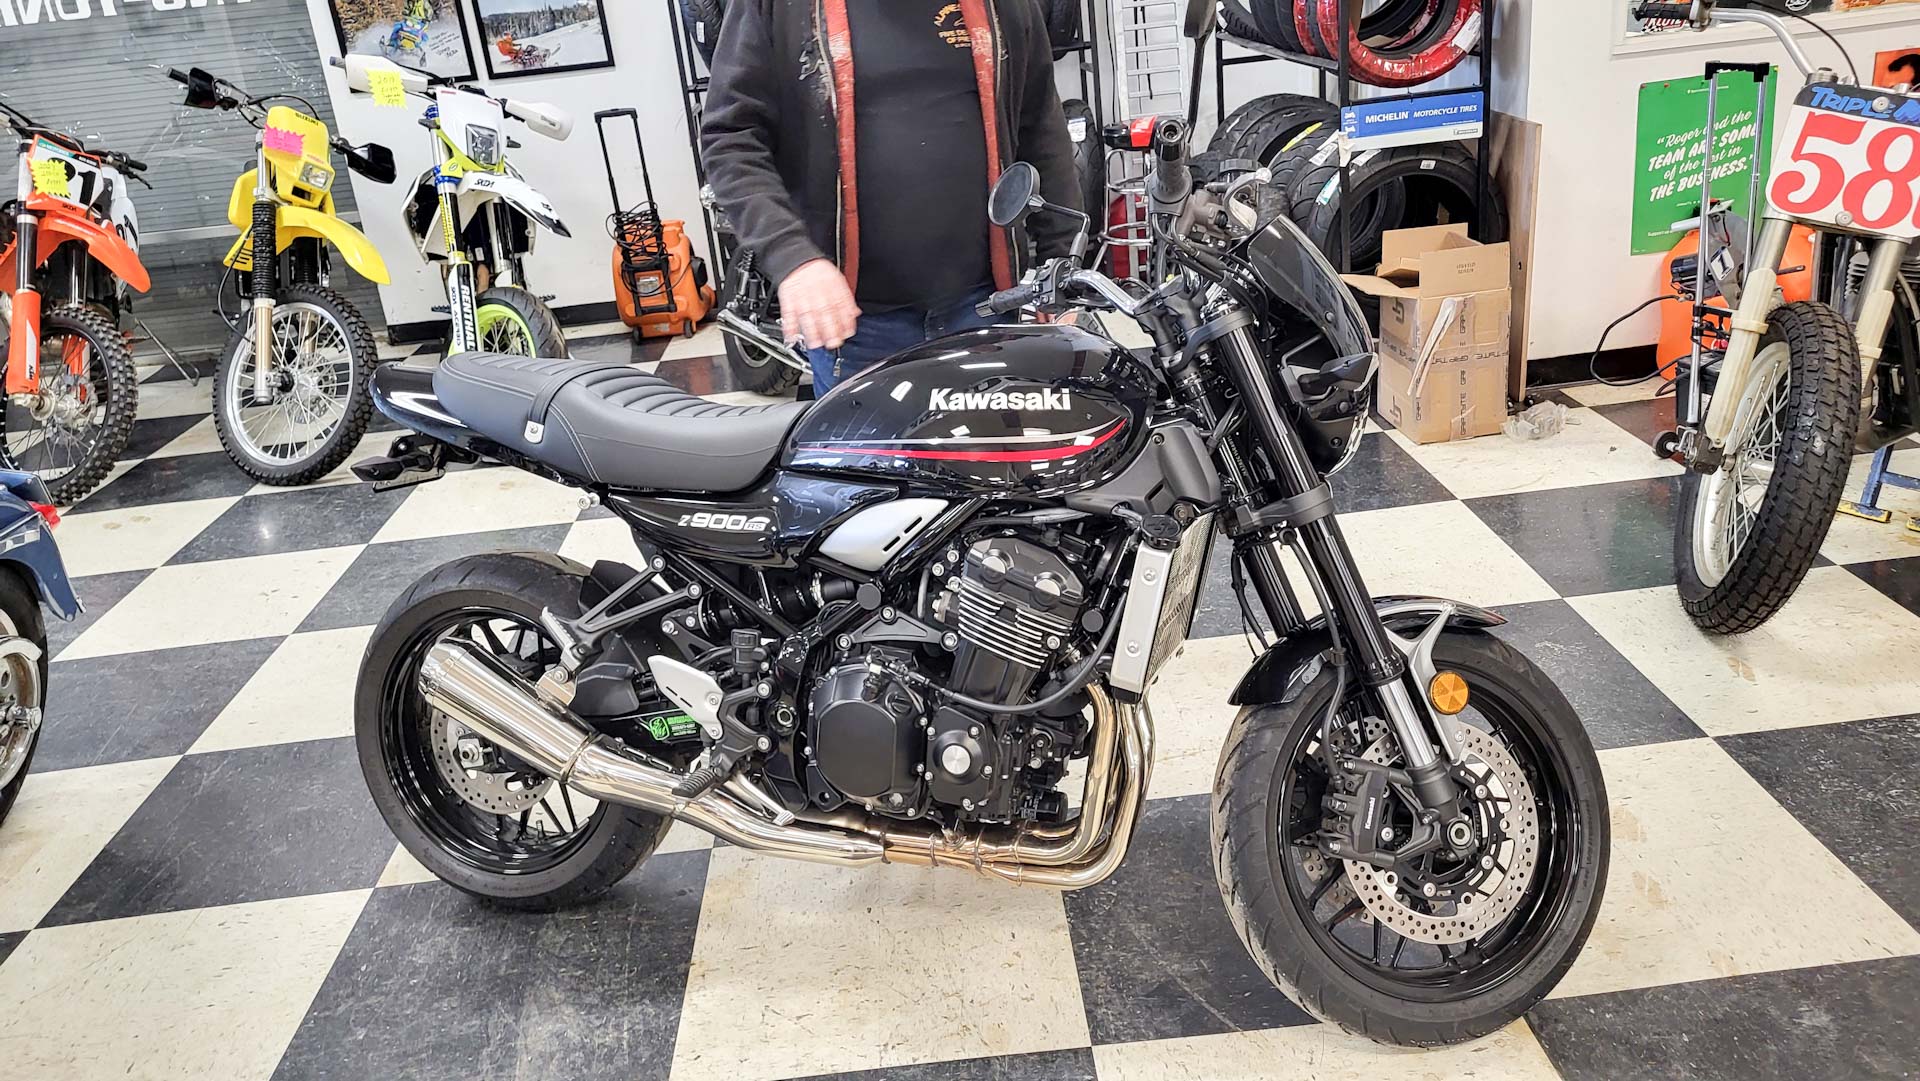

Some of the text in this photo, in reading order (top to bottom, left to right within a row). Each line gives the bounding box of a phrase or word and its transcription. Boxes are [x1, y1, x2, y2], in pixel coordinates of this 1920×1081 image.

[1365, 111, 1409, 124] MICHELIN
[1413, 107, 1458, 118] MOTORCYCLE
[1460, 104, 1478, 113] TIRES
[1810, 86, 1896, 119] TRIPL
[1731, 110, 1753, 126] the
[1648, 146, 1687, 172] TEAM
[1663, 145, 1743, 182] of the est in
[1771, 111, 1920, 230] 58
[1649, 180, 1677, 202] THE
[460, 284, 476, 351] RENTHAL
[928, 387, 1072, 411] Kawasaki
